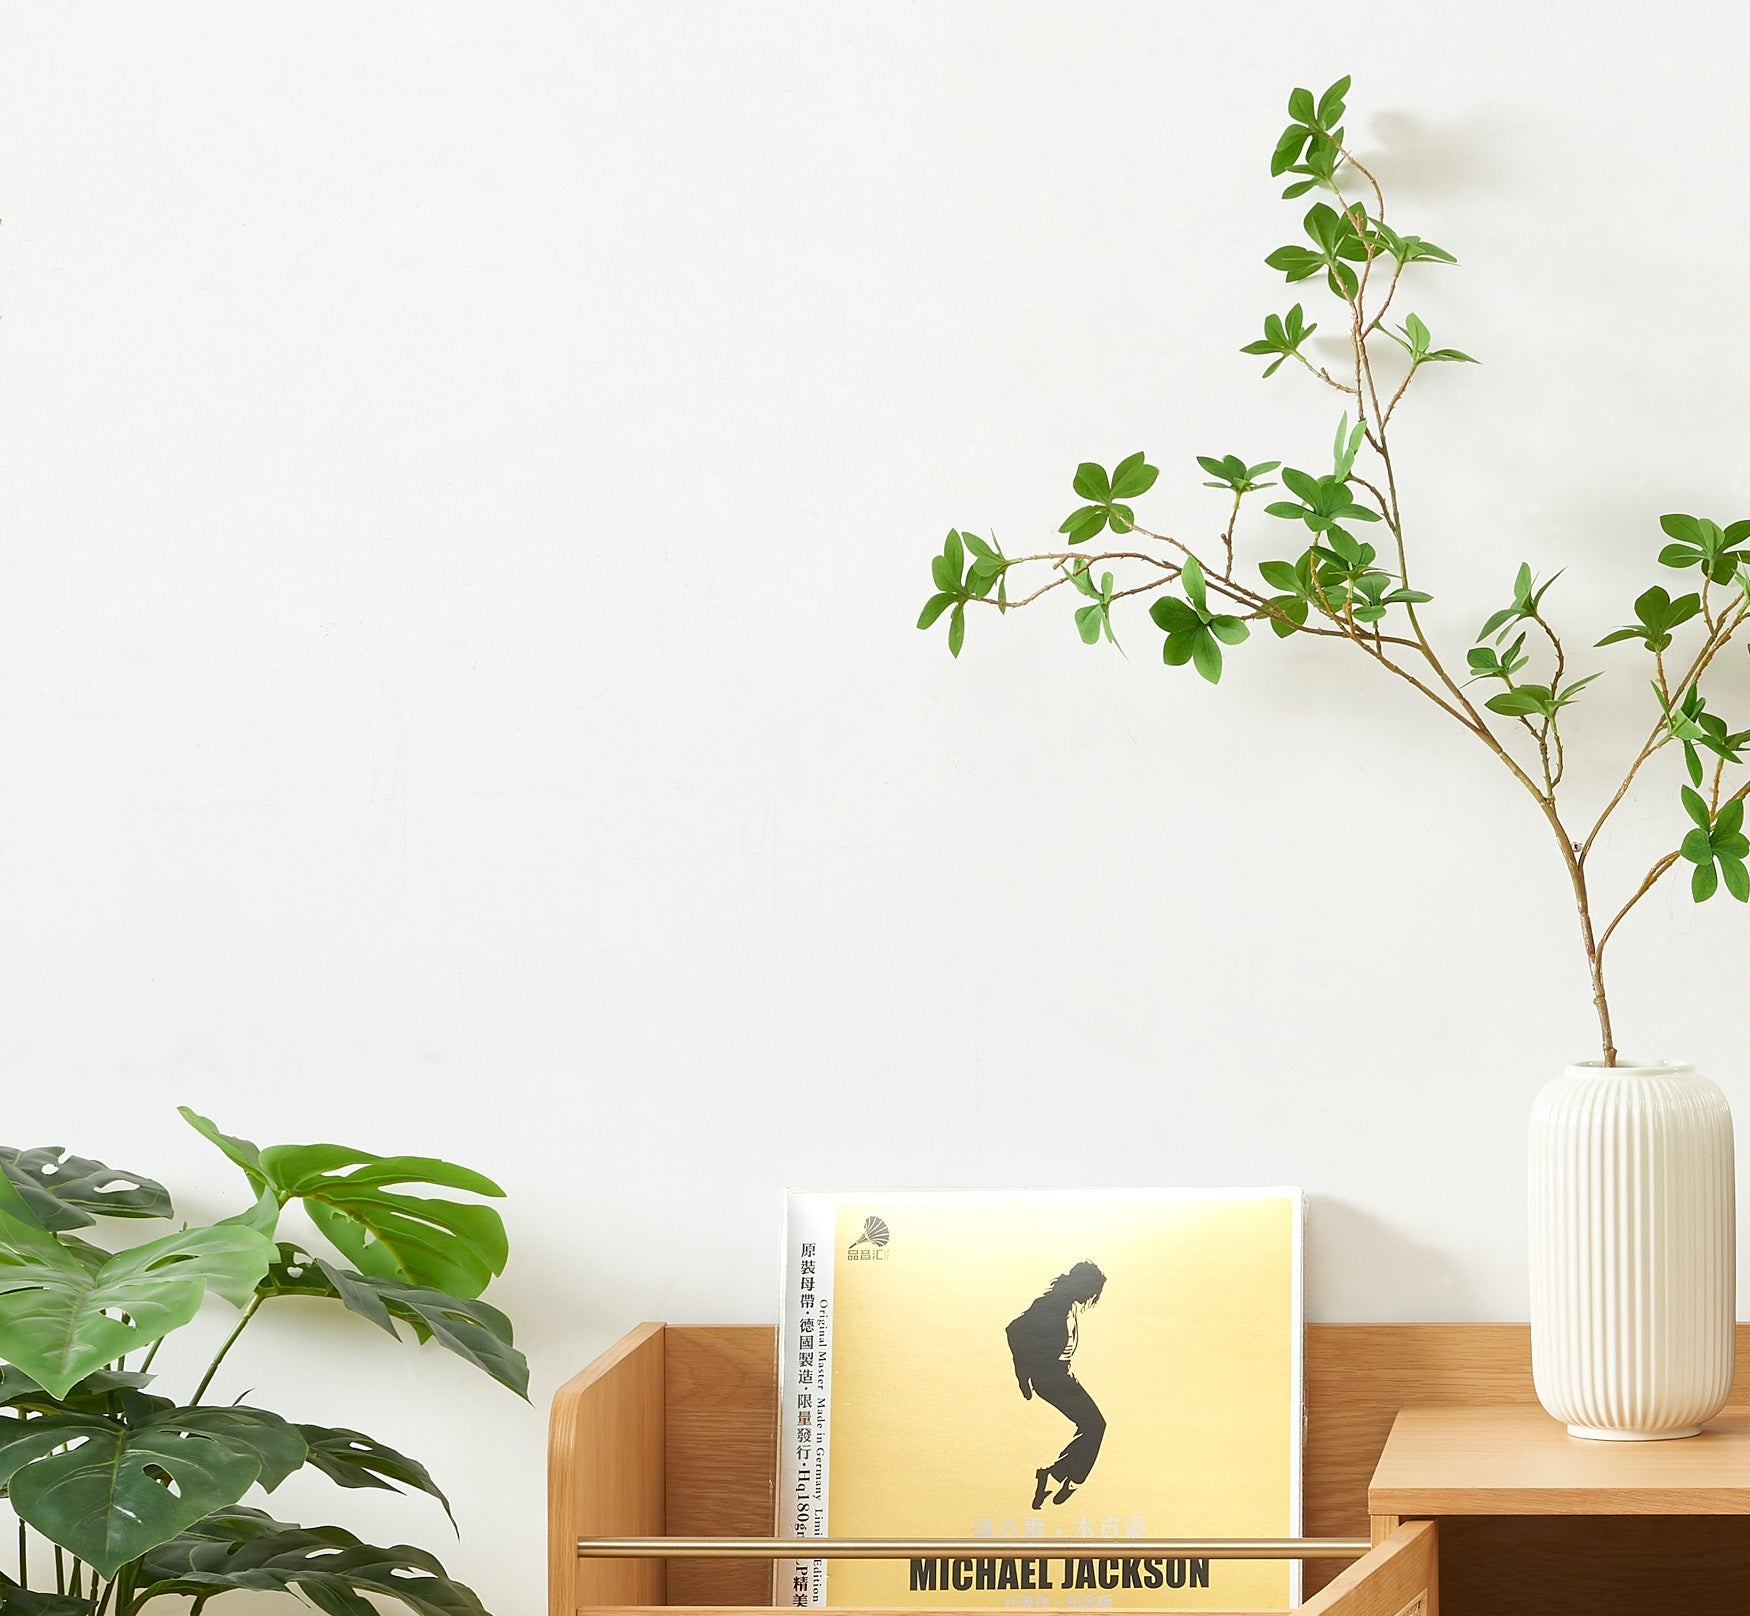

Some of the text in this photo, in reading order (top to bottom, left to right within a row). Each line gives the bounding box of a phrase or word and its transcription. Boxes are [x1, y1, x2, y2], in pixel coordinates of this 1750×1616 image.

[816, 1299, 829, 1347] Original
[817, 1351, 827, 1390] Master
[816, 1397, 826, 1429] Made
[816, 1432, 826, 1443] in
[813, 1447, 825, 1500] Germany
[814, 1509, 823, 1537] Limi
[909, 1558, 1209, 1591] MICHAEL JACKSON
